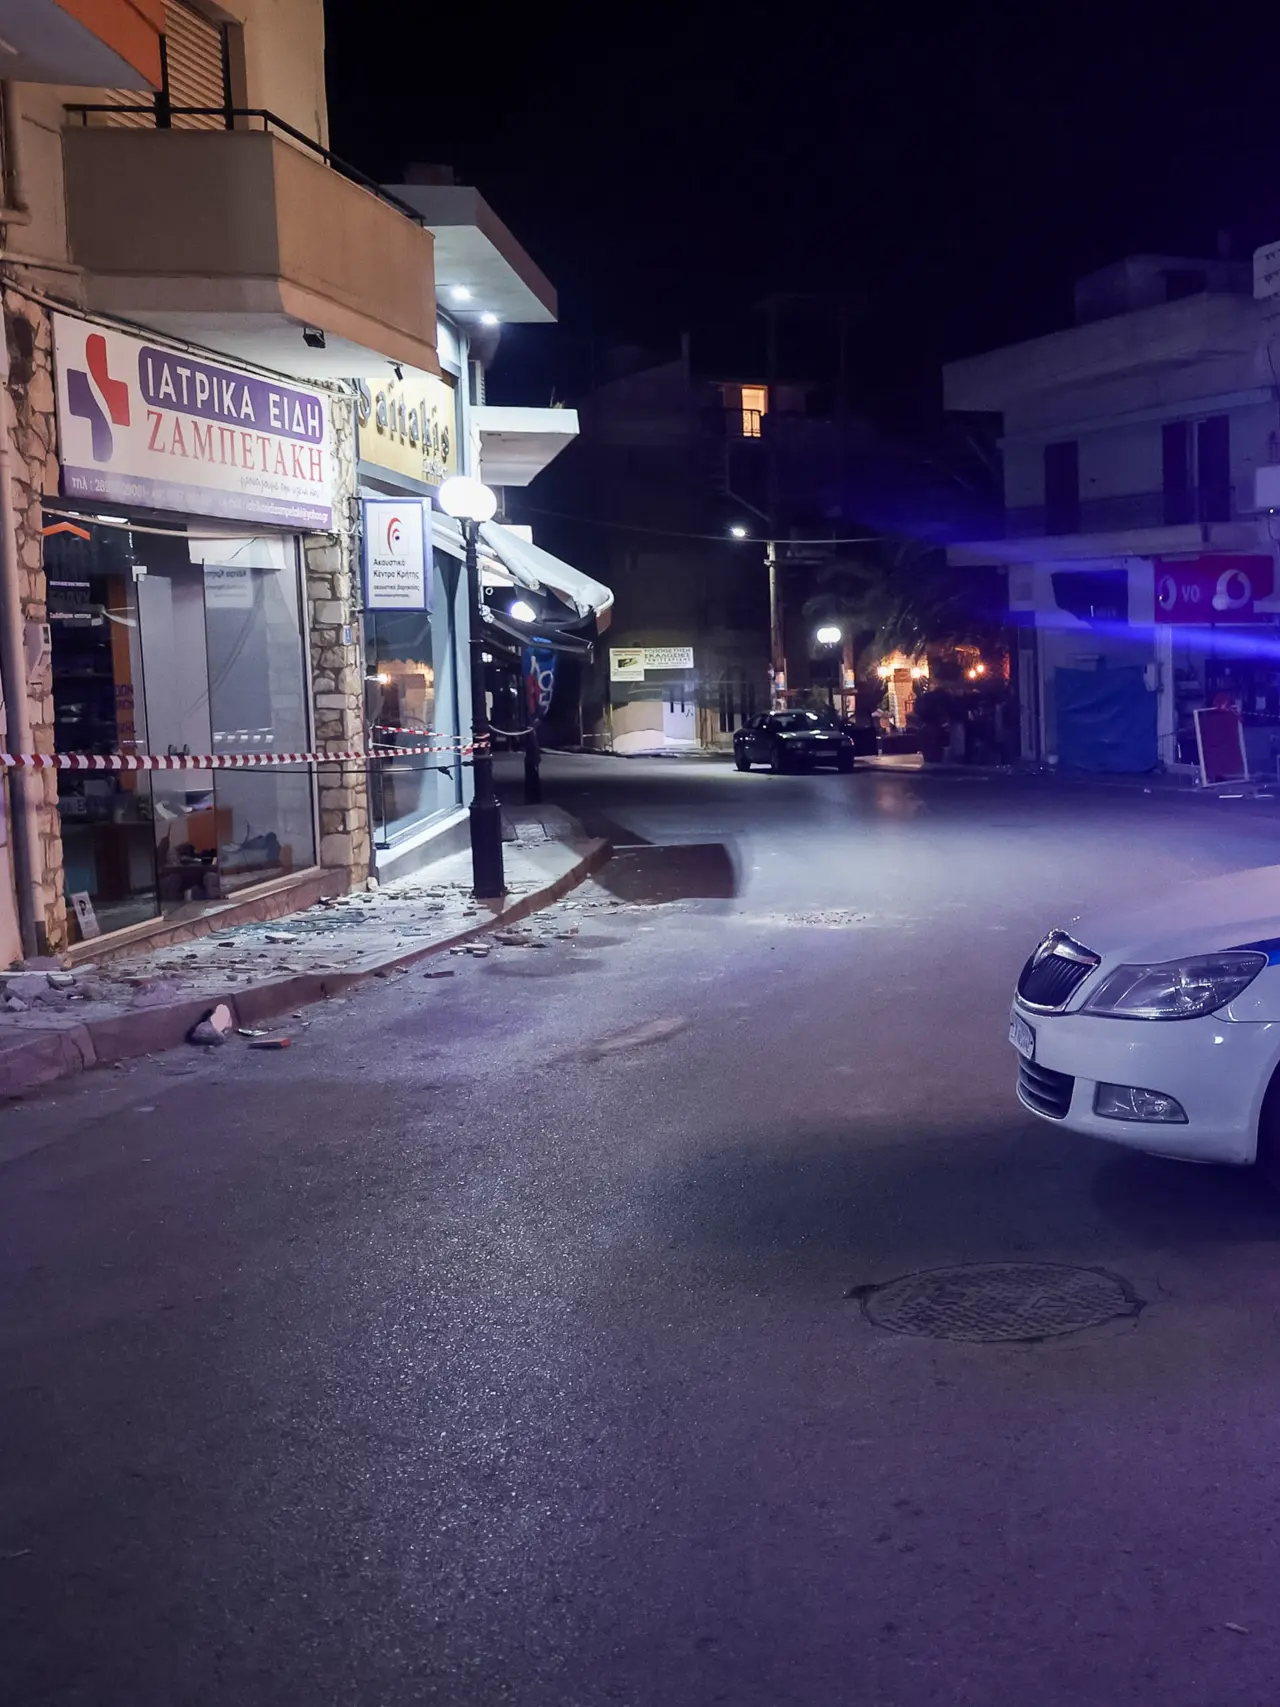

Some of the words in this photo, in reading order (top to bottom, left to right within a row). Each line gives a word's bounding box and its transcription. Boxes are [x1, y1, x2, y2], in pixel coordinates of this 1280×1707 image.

[147, 357, 256, 423] ΙΑΤΡΙΚΑ
[268, 392, 320, 438] ΕΙΔΗ
[147, 409, 324, 483] ΖΑΜΠΕΤΑΚΗ
